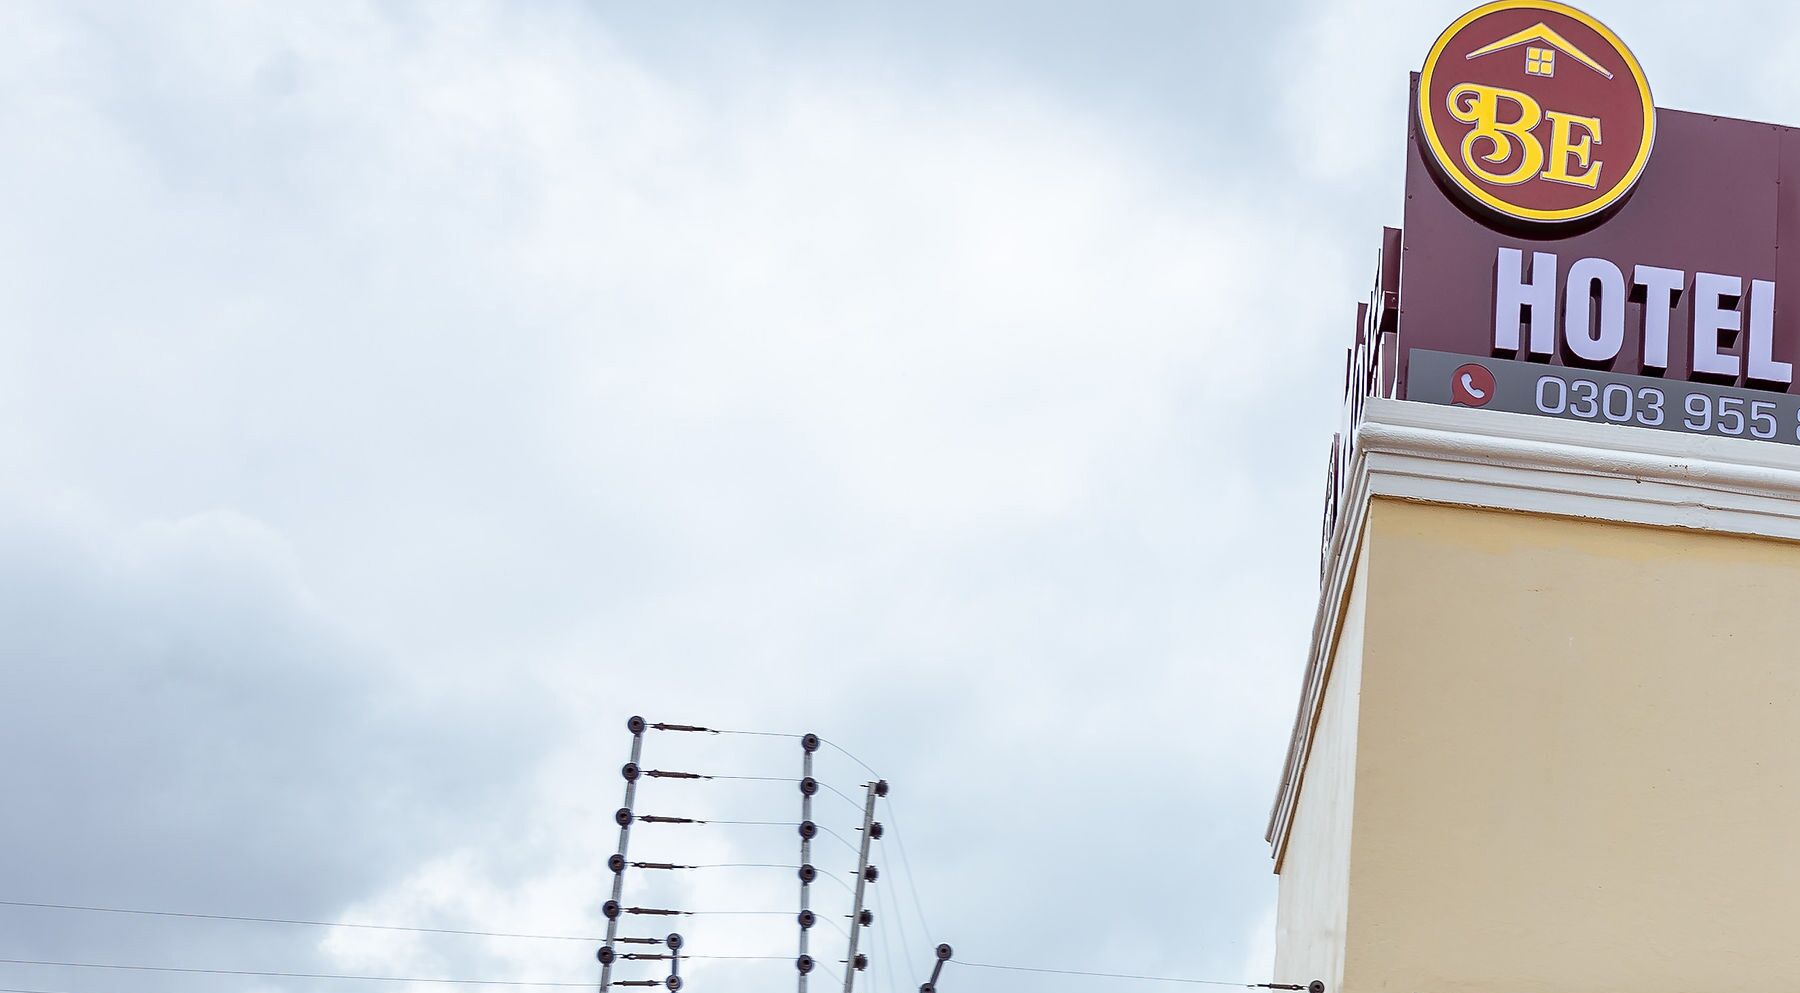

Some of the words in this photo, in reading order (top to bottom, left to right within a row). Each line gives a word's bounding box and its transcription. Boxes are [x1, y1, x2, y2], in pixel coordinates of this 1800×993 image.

[1446, 82, 1603, 190] BE
[1494, 247, 1793, 384] HOTEL
[1535, 376, 1665, 426] 0303
[1684, 396, 1777, 438] 955
